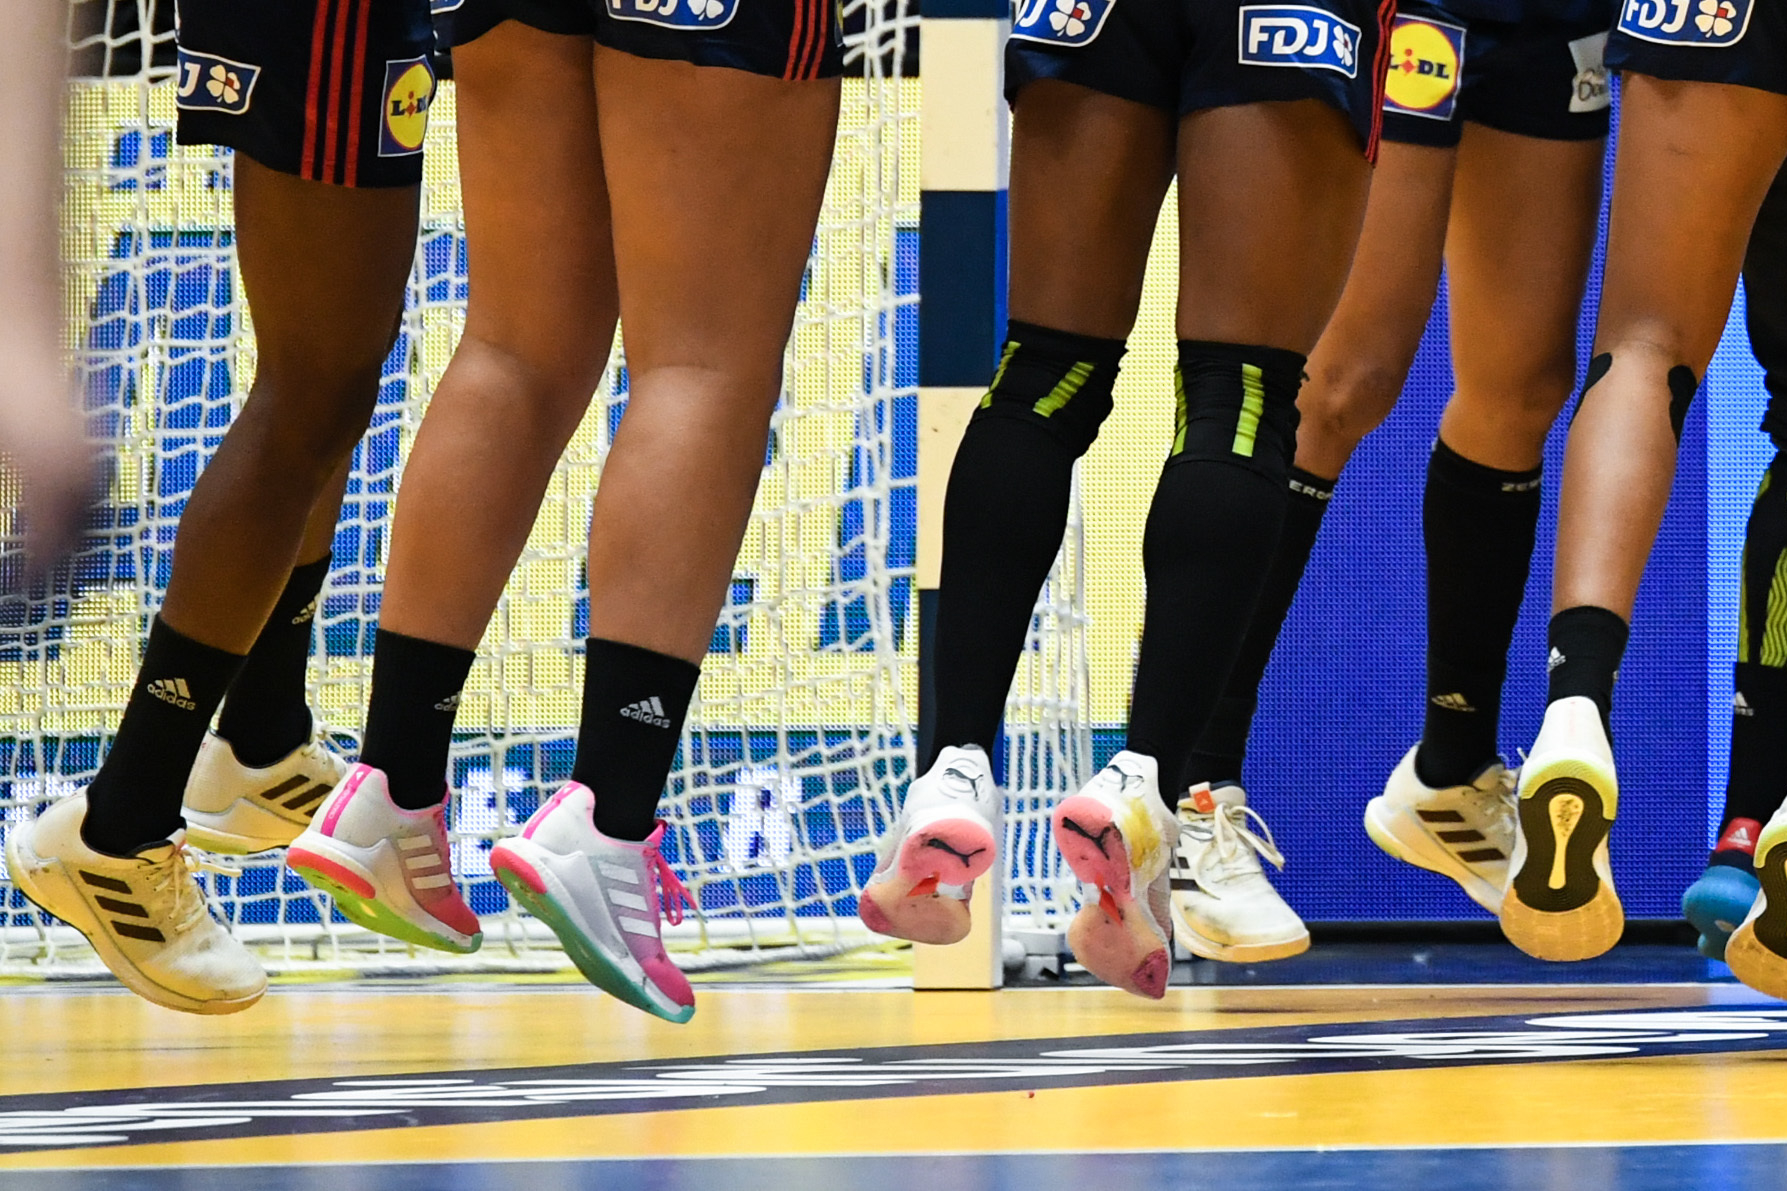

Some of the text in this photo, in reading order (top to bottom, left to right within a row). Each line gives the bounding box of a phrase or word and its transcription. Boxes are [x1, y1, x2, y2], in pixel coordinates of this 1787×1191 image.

[1249, 17, 1329, 57] FDJ
[147, 683, 196, 711] adidas
[620, 707, 671, 728] adidas
